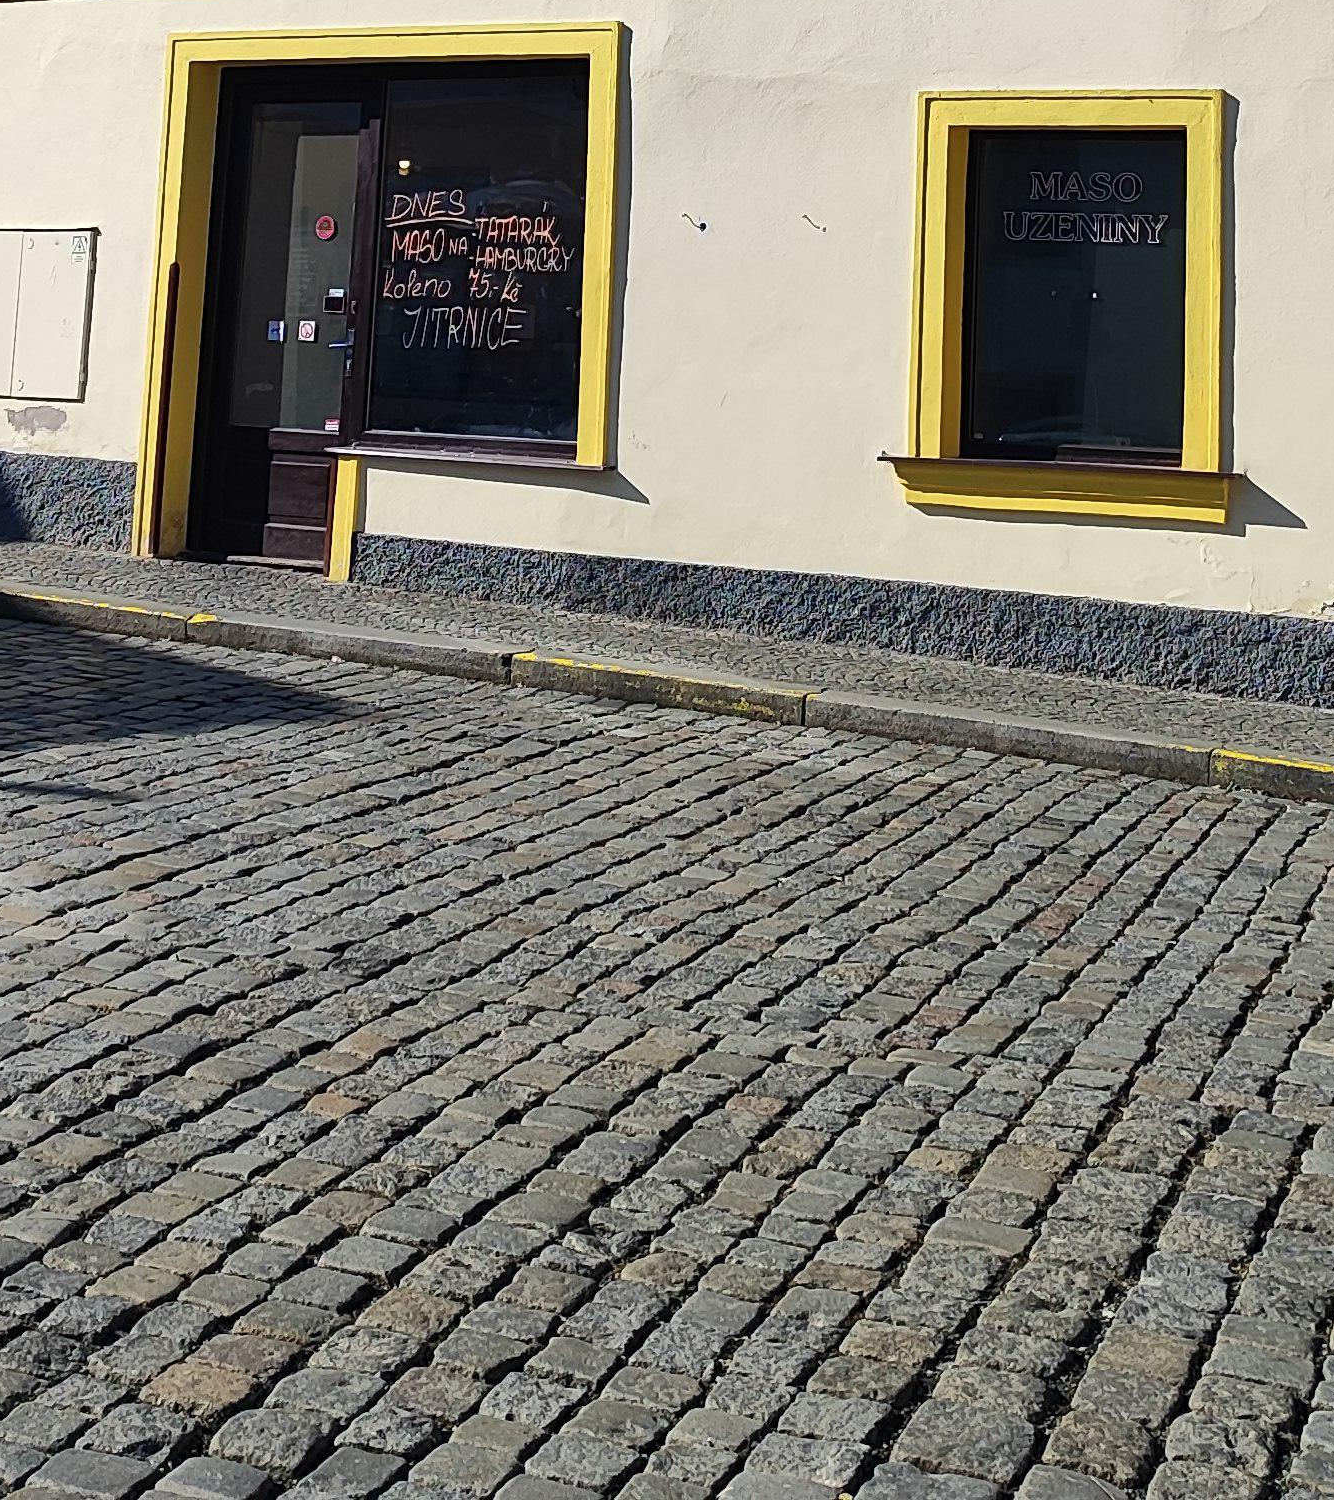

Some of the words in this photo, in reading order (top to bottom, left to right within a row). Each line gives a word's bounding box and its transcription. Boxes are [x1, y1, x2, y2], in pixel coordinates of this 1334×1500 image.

[1029, 171, 1144, 203] MASO
[385, 189, 466, 221] DNES
[1003, 211, 1170, 244] UZENINY
[391, 228, 445, 263] MASO
[449, 237, 467, 256] NA
[402, 305, 528, 351] JITRNICE
